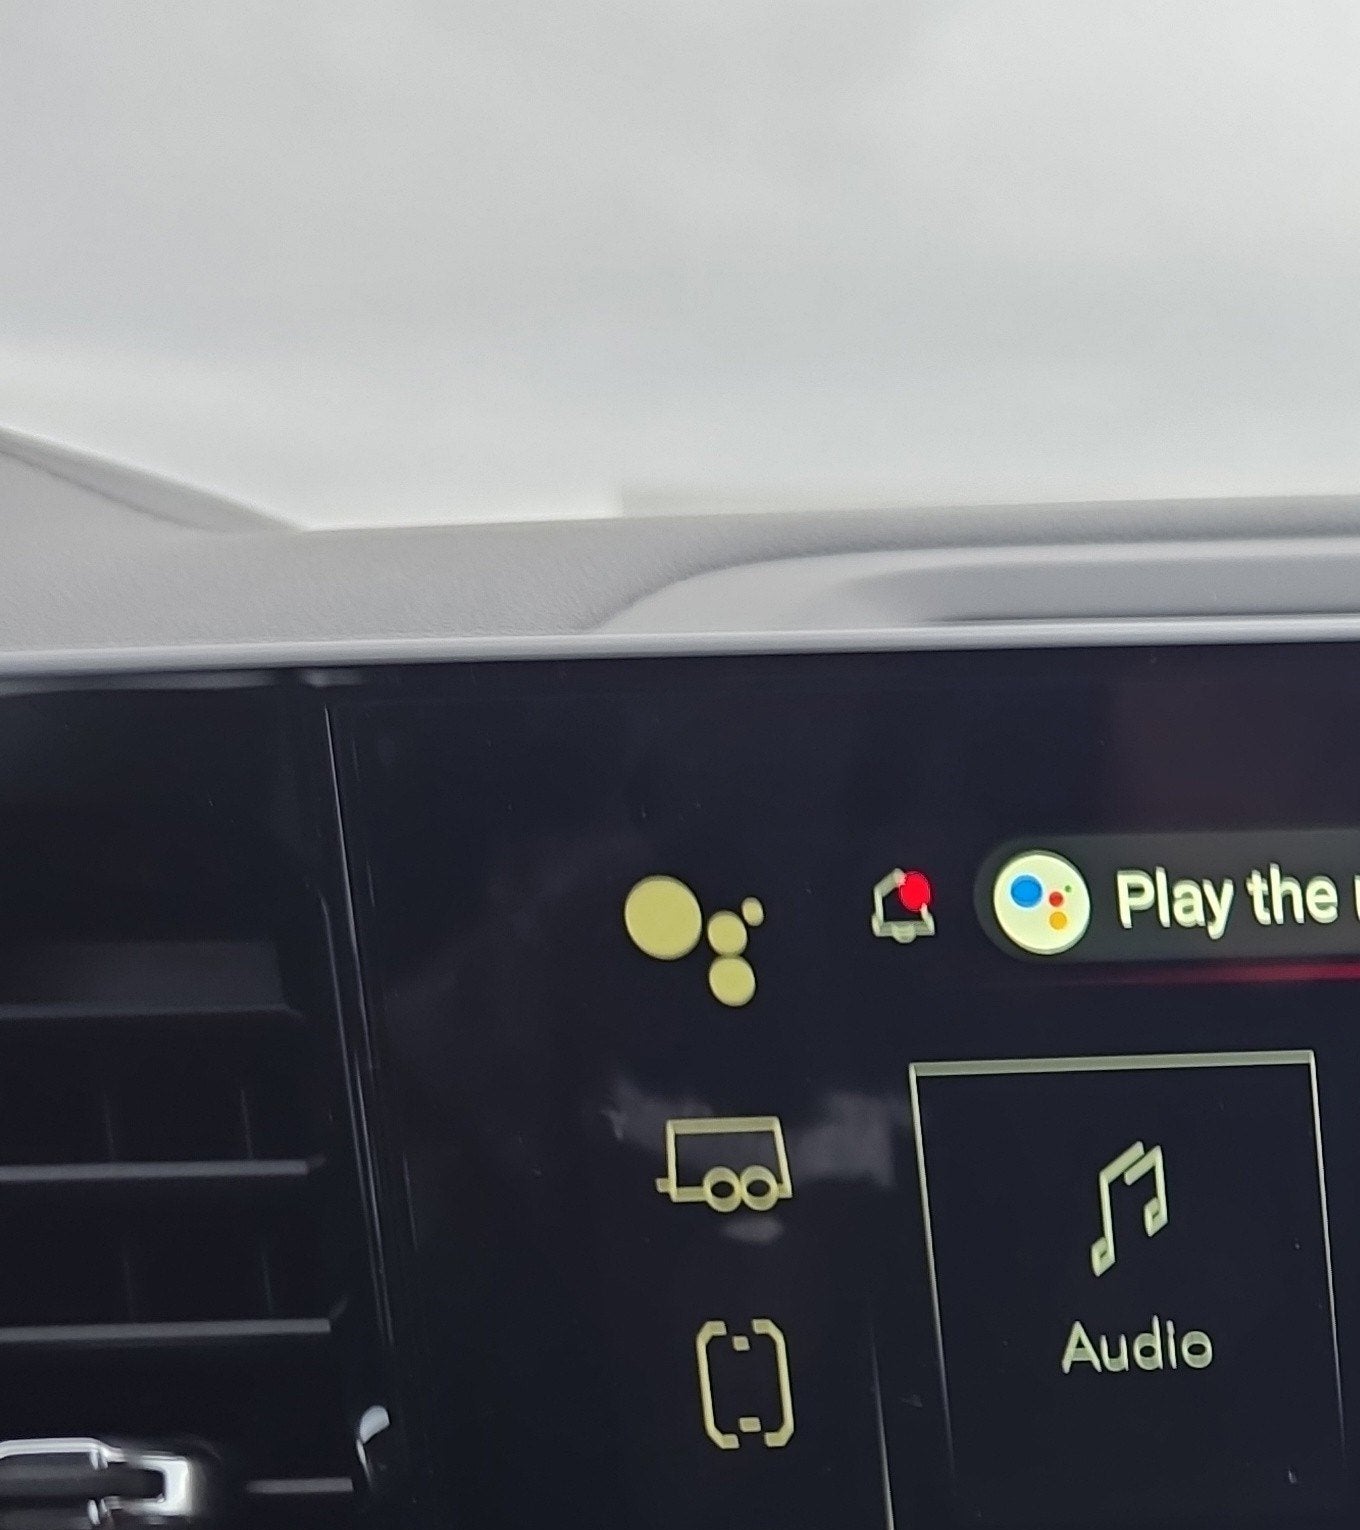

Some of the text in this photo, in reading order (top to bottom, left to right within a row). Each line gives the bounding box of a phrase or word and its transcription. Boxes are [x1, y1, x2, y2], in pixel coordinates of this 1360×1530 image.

[1116, 866, 1234, 940] Play
[1246, 862, 1338, 924] the
[1061, 1315, 1214, 1374] Audio
